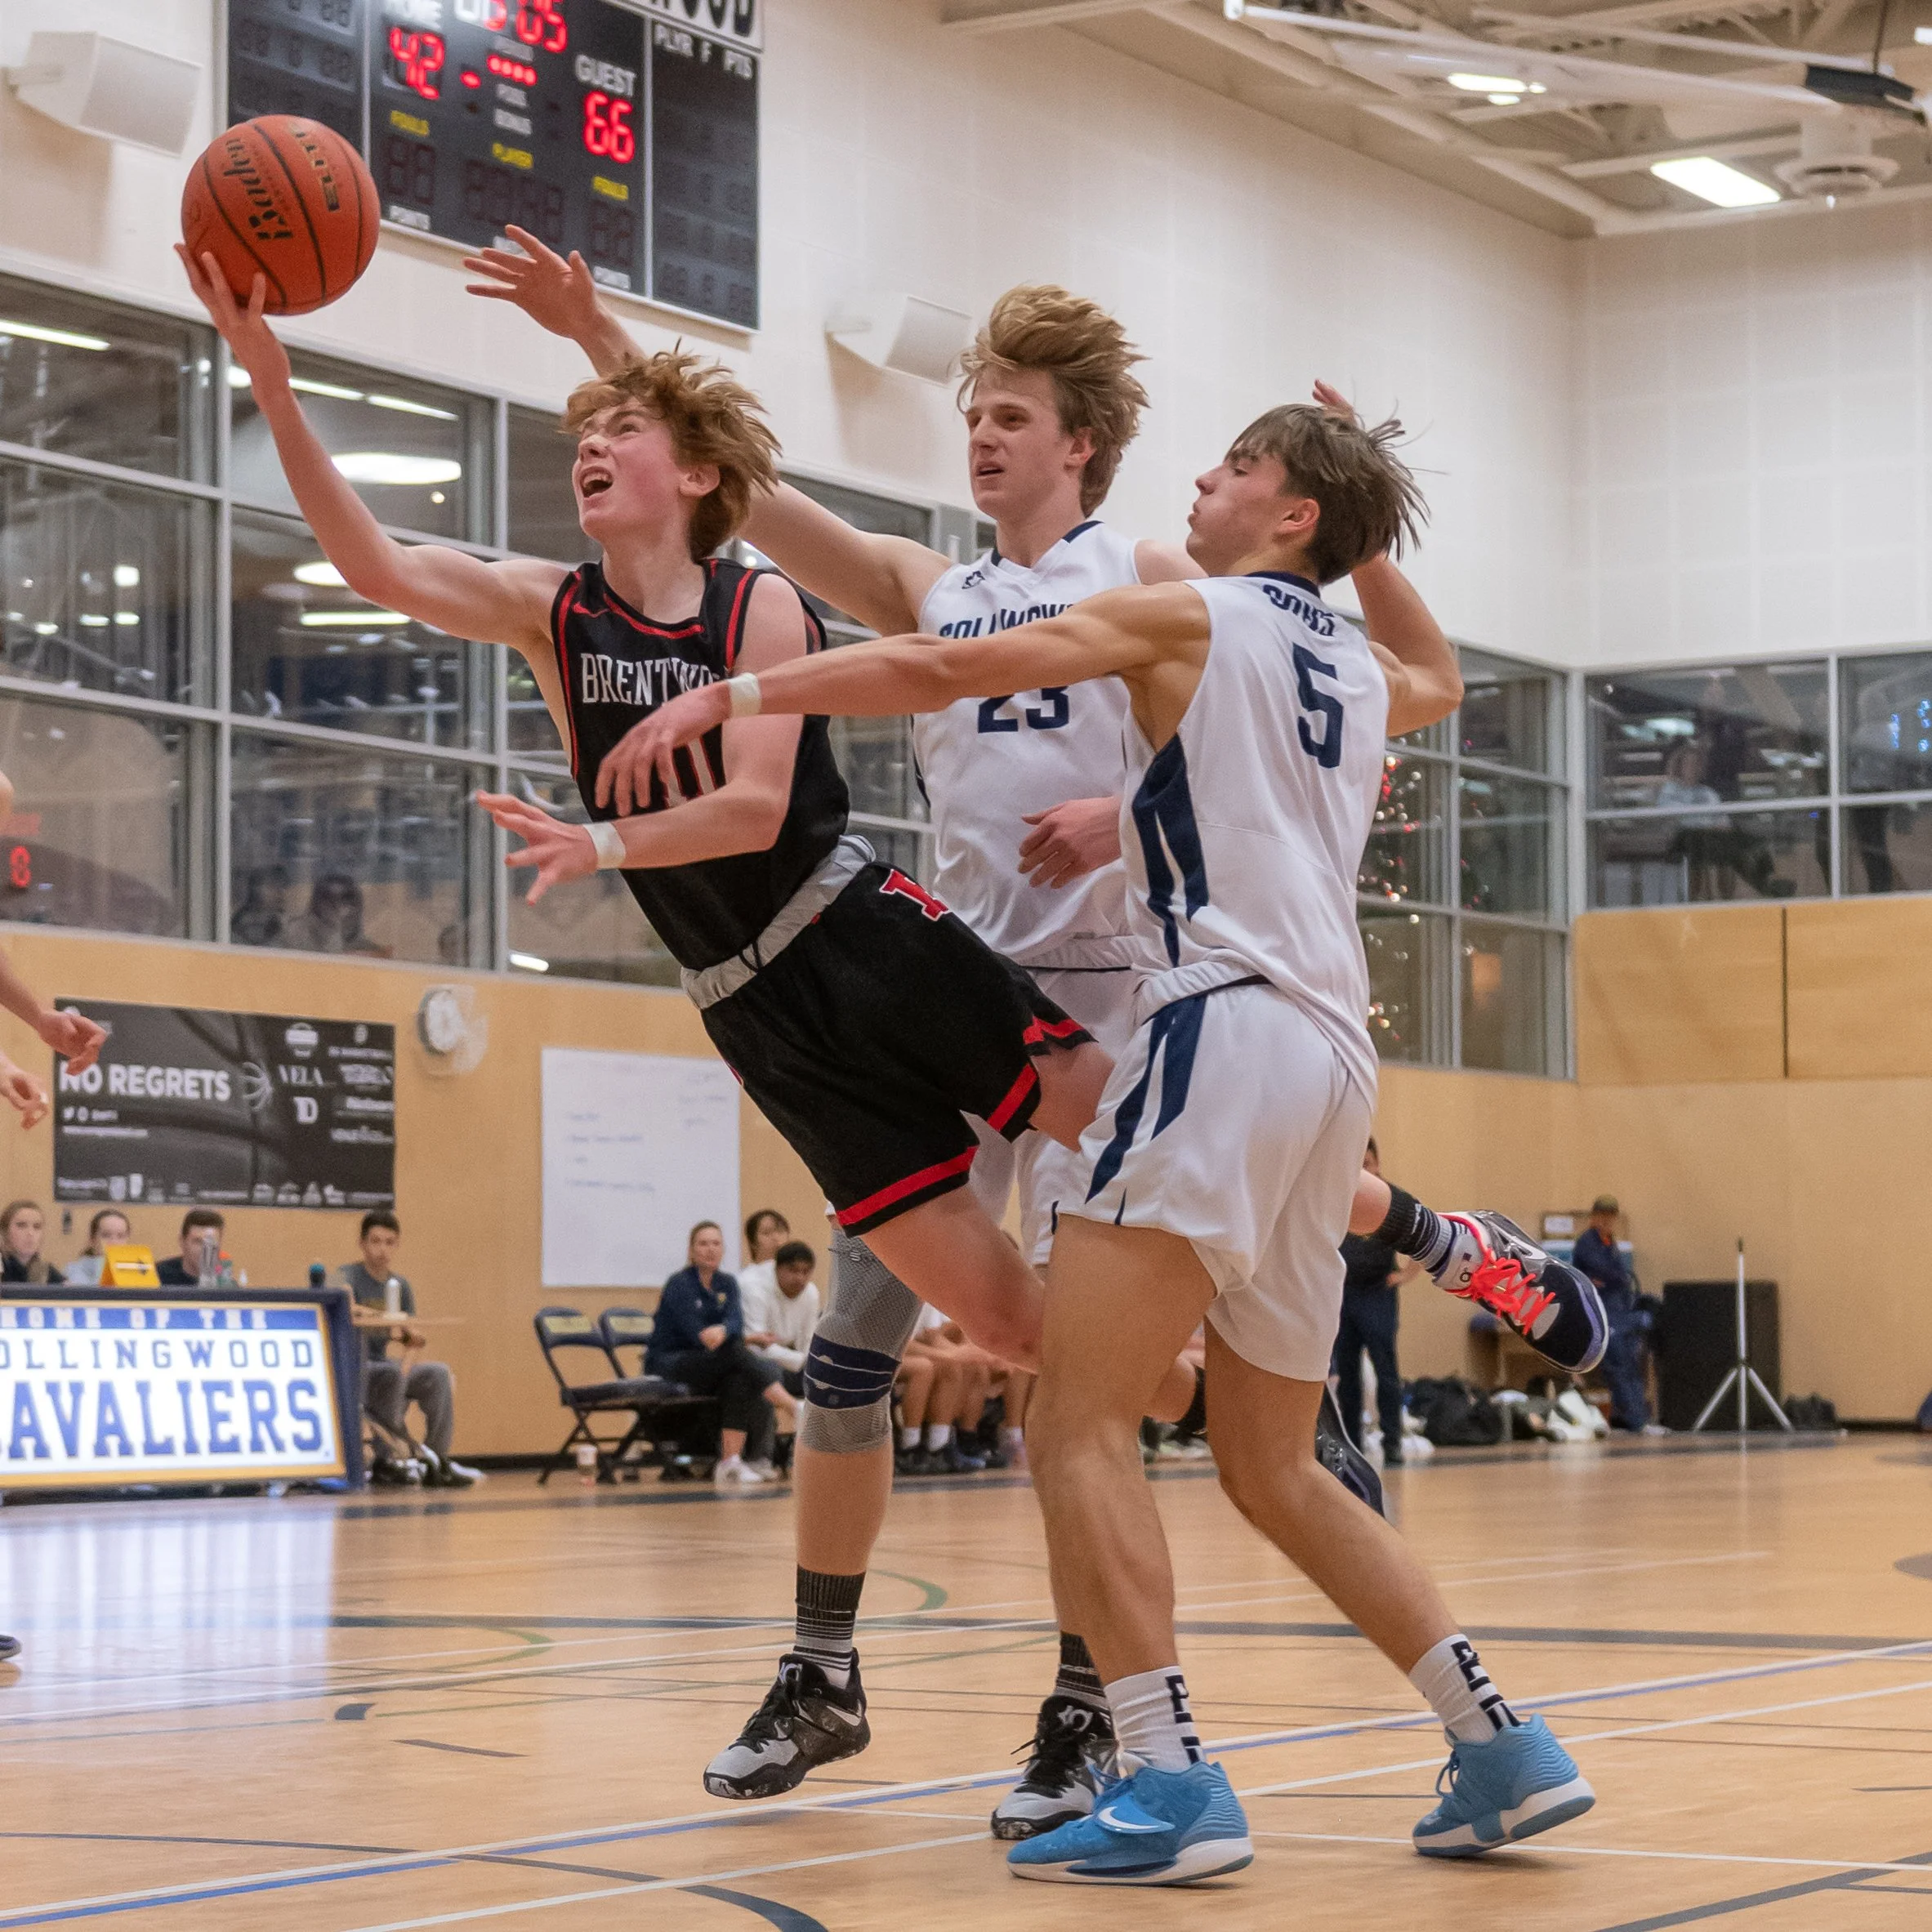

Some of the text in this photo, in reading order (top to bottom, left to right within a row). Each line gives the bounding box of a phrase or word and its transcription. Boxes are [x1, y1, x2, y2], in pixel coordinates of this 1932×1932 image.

[390, 27, 445, 100] 42
[575, 54, 636, 98] GUEST
[583, 90, 635, 163] 66
[1292, 642, 1344, 769] 5
[60, 1061, 231, 1101] NO REGRETS
[0, 1379, 322, 1459] AVALIERS
